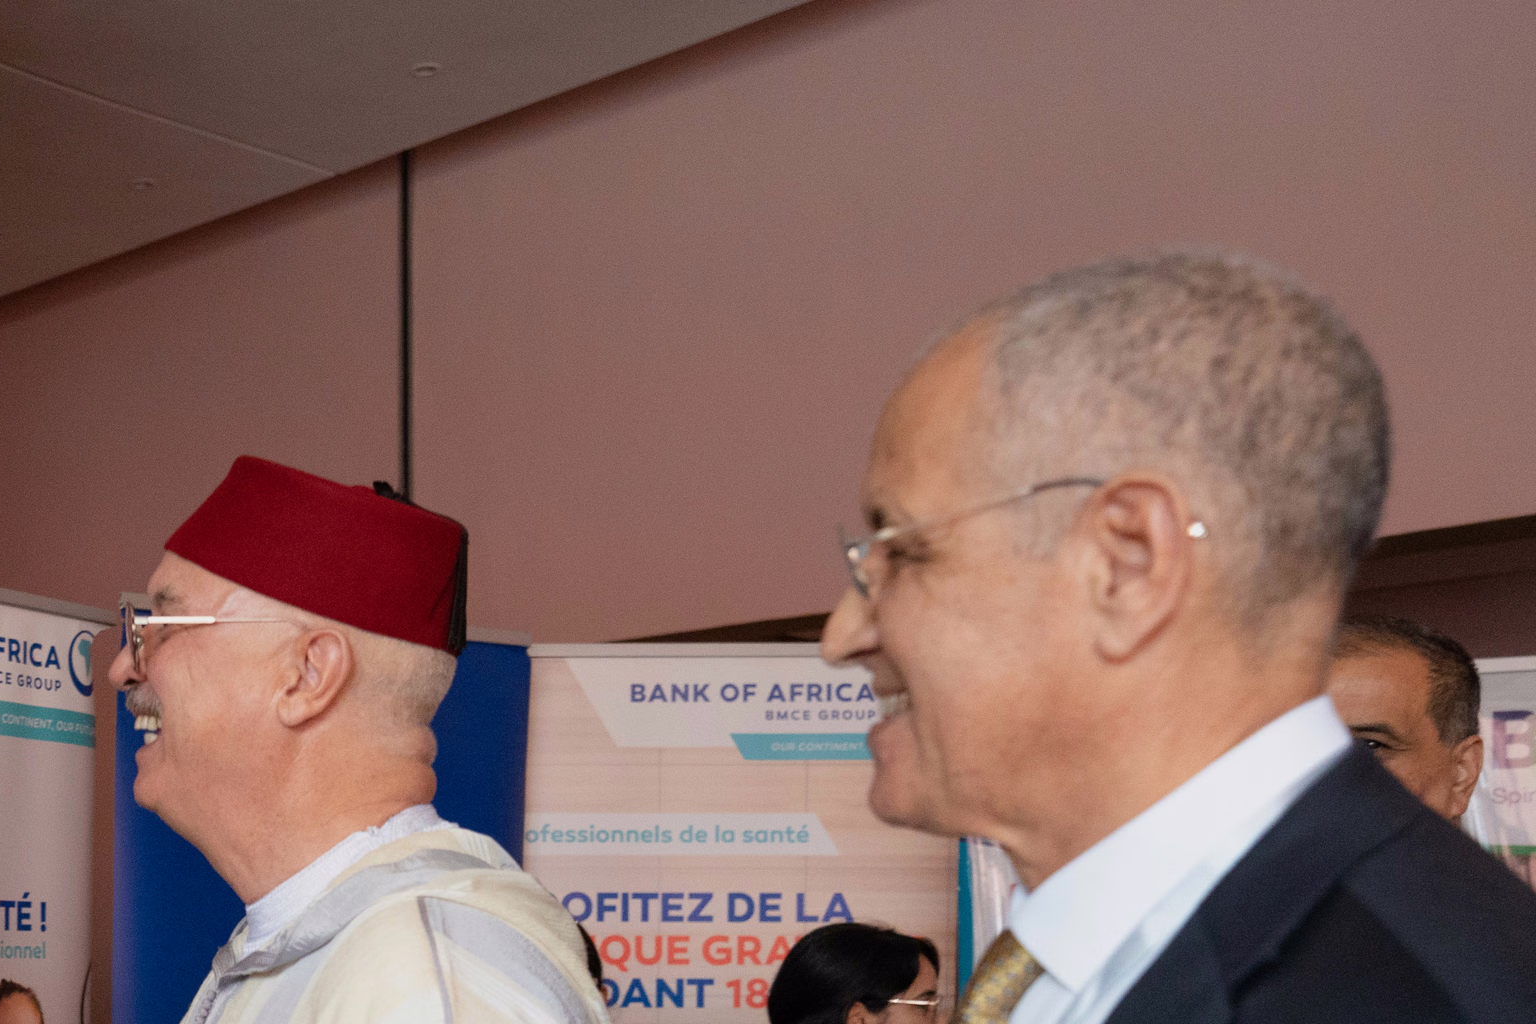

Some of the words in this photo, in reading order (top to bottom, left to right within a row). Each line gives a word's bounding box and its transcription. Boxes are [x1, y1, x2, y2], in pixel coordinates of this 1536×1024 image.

[17, 674, 62, 692] GROUP
[630, 683, 711, 703] BANK
[720, 683, 758, 703] OF
[766, 683, 876, 703] AFRICA
[765, 710, 811, 721] BMCE
[818, 709, 876, 721] GROUP
[679, 825, 708, 844] de
[715, 824, 735, 844] la
[742, 824, 810, 844] santé
[561, 892, 714, 923] OFITEZ
[727, 892, 783, 923] DE
[796, 893, 854, 923] LA
[590, 934, 691, 972] QUE
[702, 934, 804, 966] GRA
